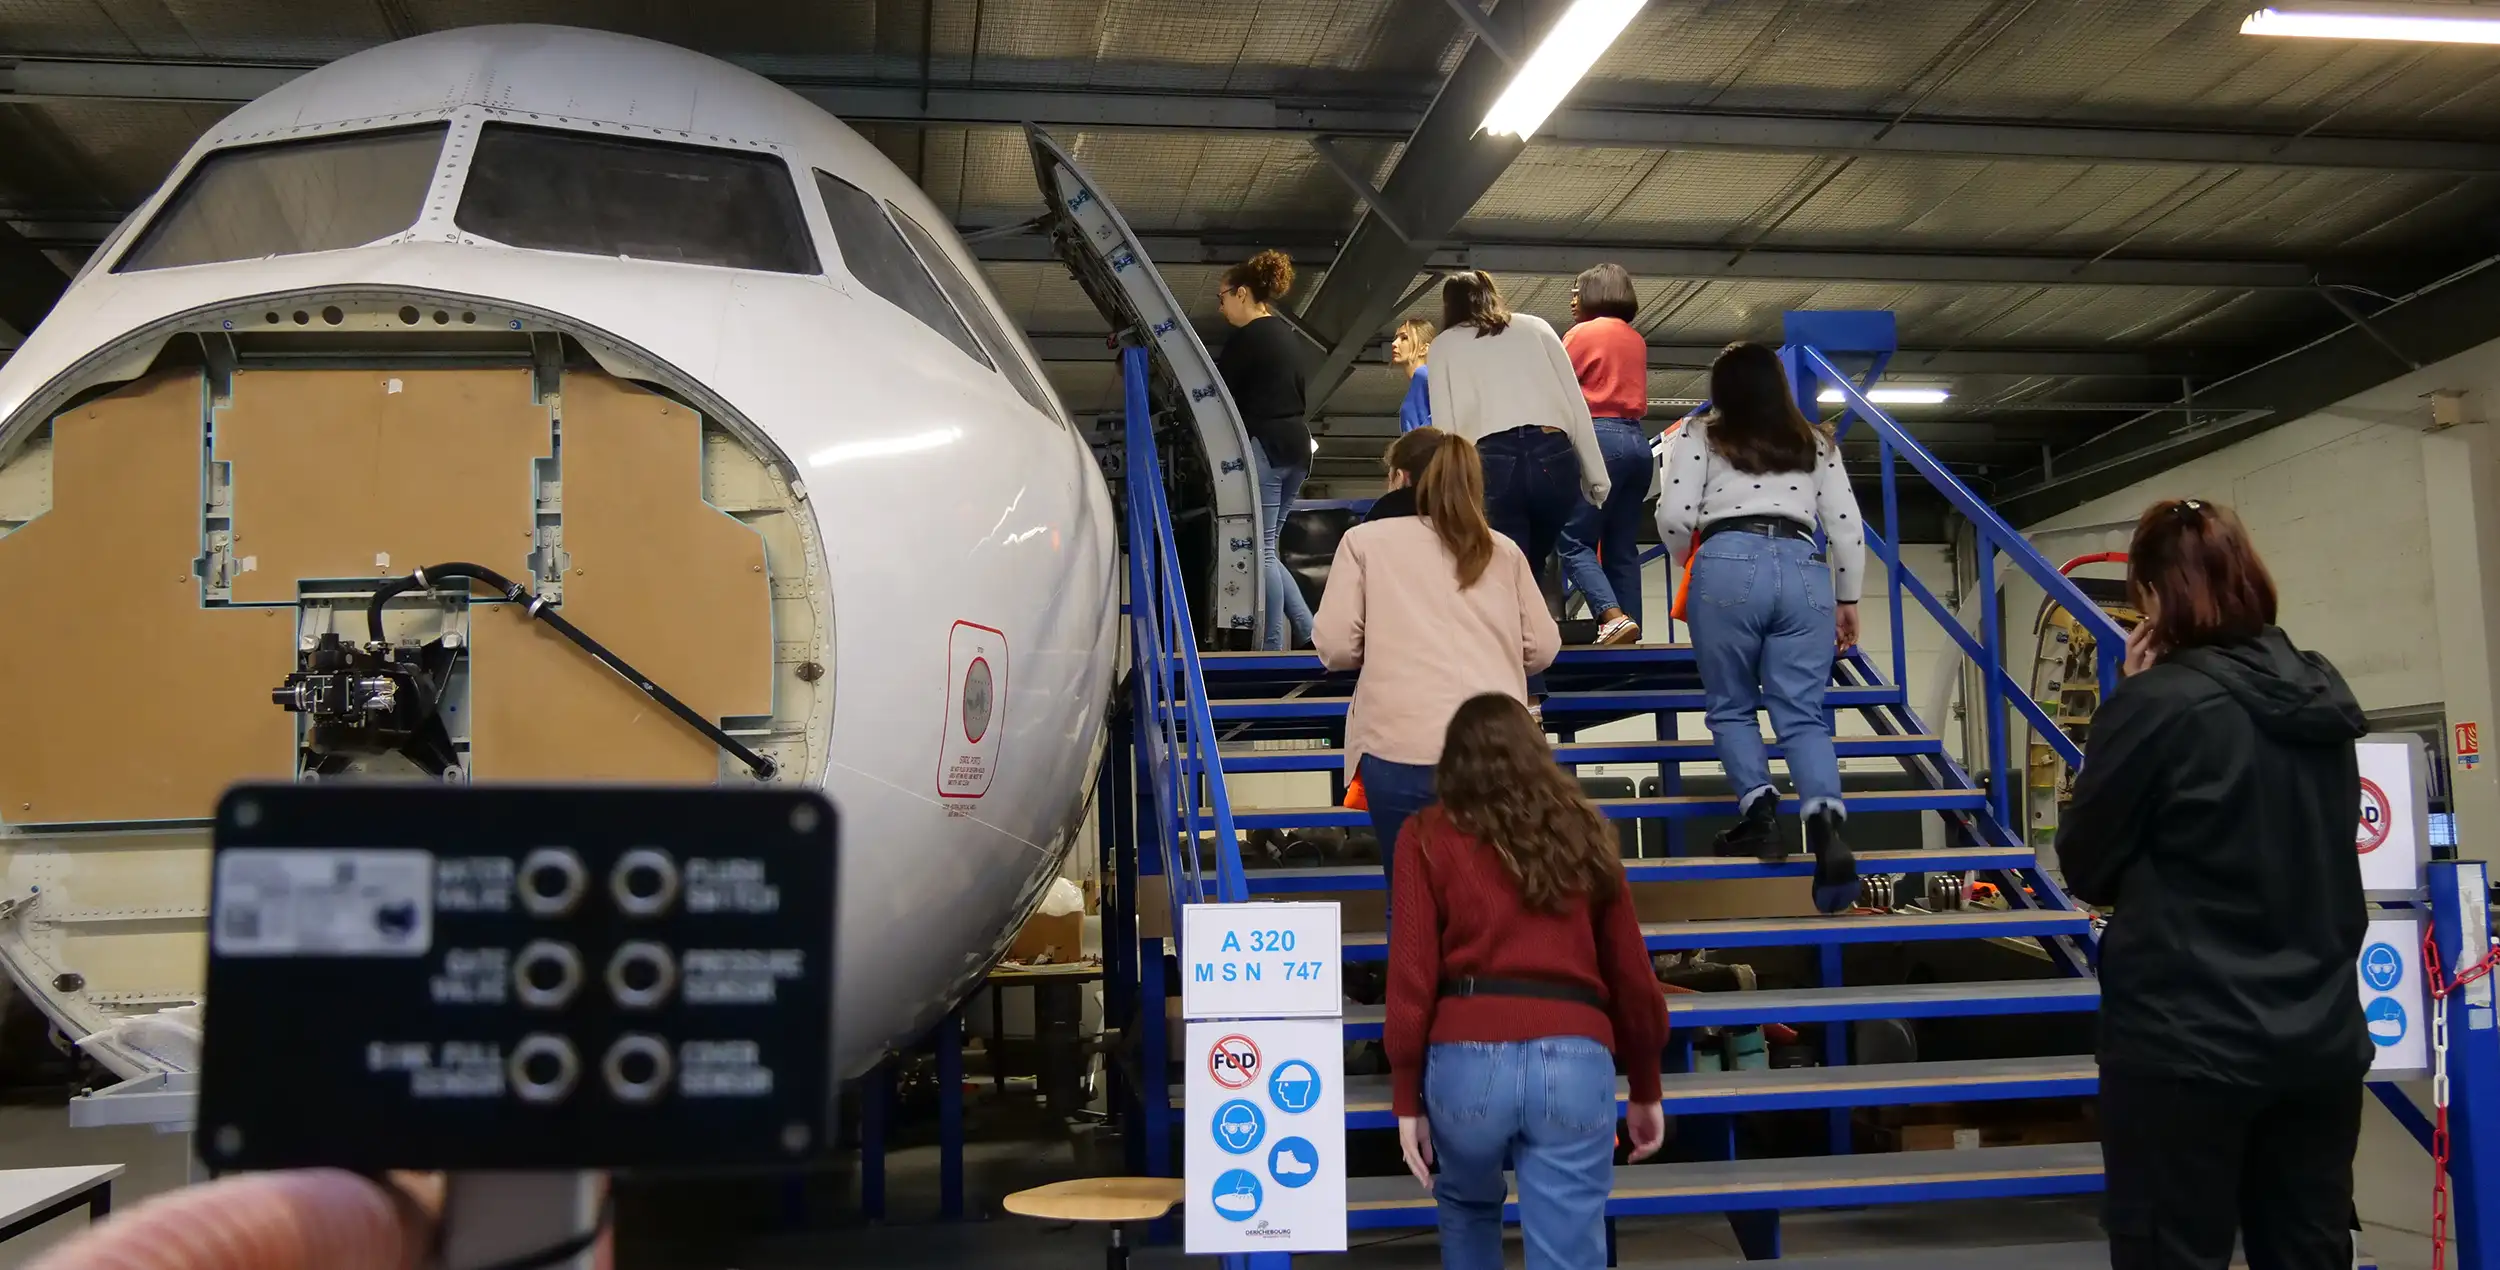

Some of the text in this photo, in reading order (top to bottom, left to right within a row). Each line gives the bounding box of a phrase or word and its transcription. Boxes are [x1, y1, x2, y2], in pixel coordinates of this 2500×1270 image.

[1221, 929, 1295, 952] A 320
[1283, 961, 1322, 981] 747
[1214, 1053, 1256, 1070] FOD
